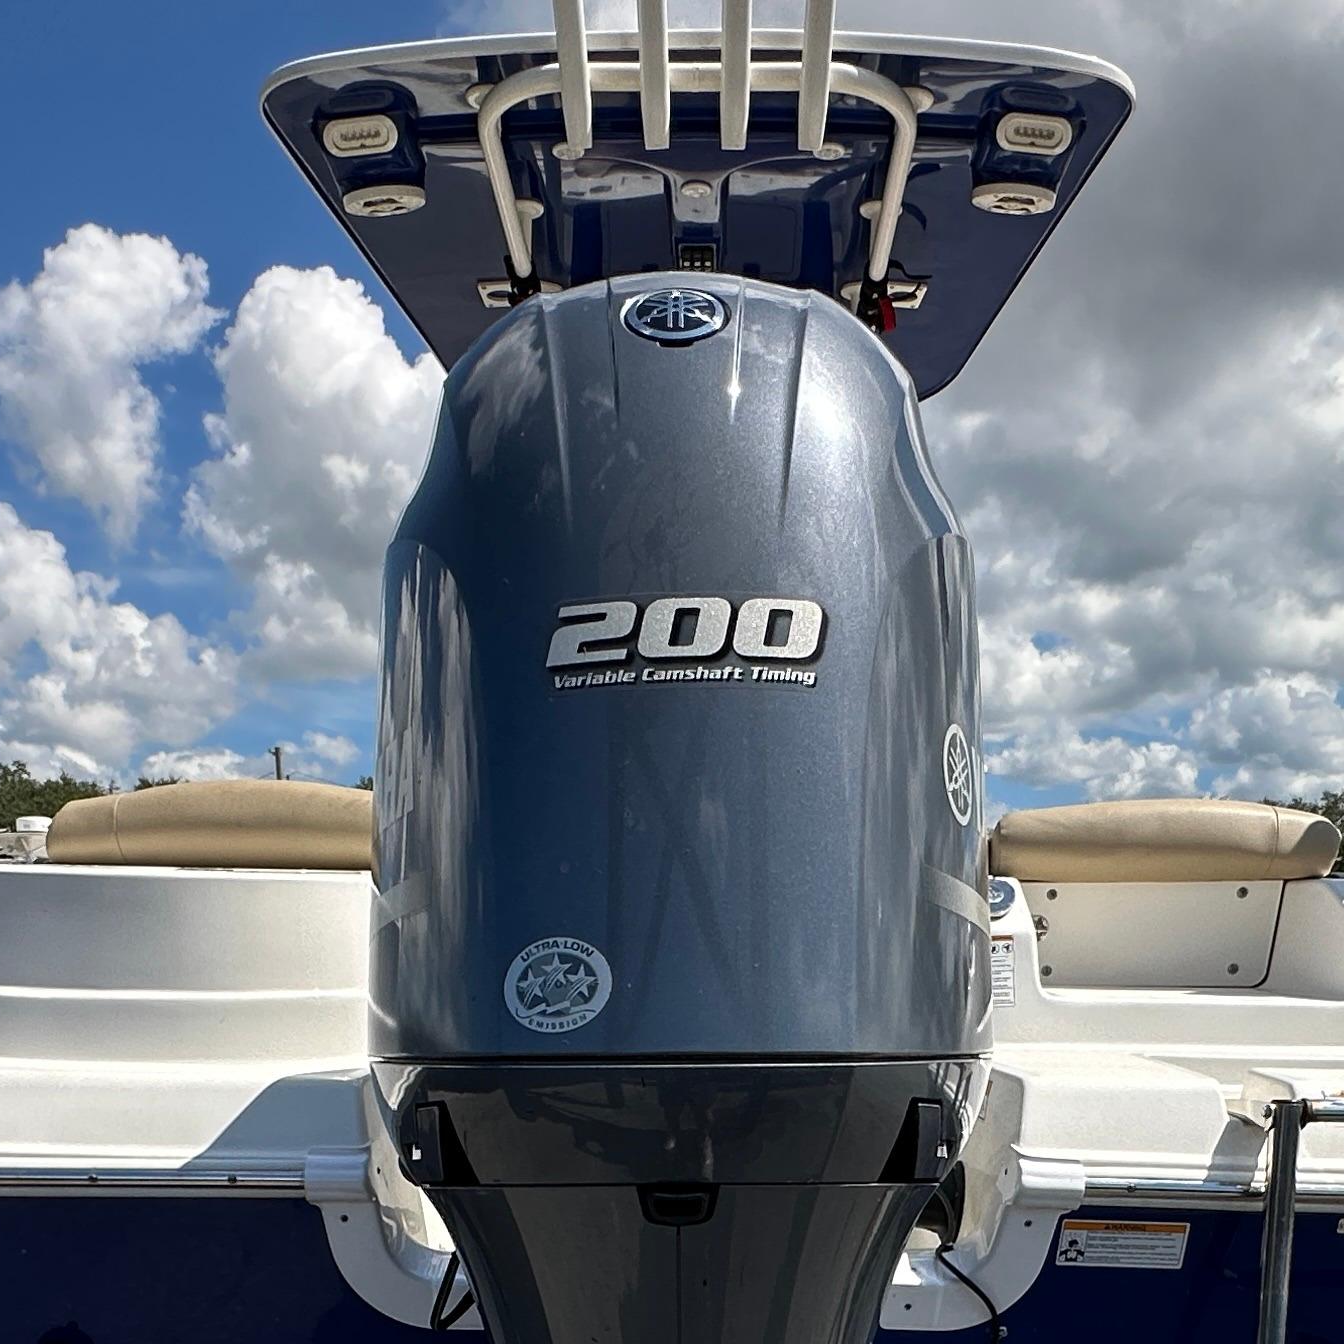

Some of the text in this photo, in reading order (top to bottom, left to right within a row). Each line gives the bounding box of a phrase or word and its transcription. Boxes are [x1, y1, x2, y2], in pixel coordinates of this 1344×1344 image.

[546, 597, 823, 668] 200
[554, 666, 817, 689] Variable Camshaft Timing
[528, 1013, 588, 1030] EMISSION
